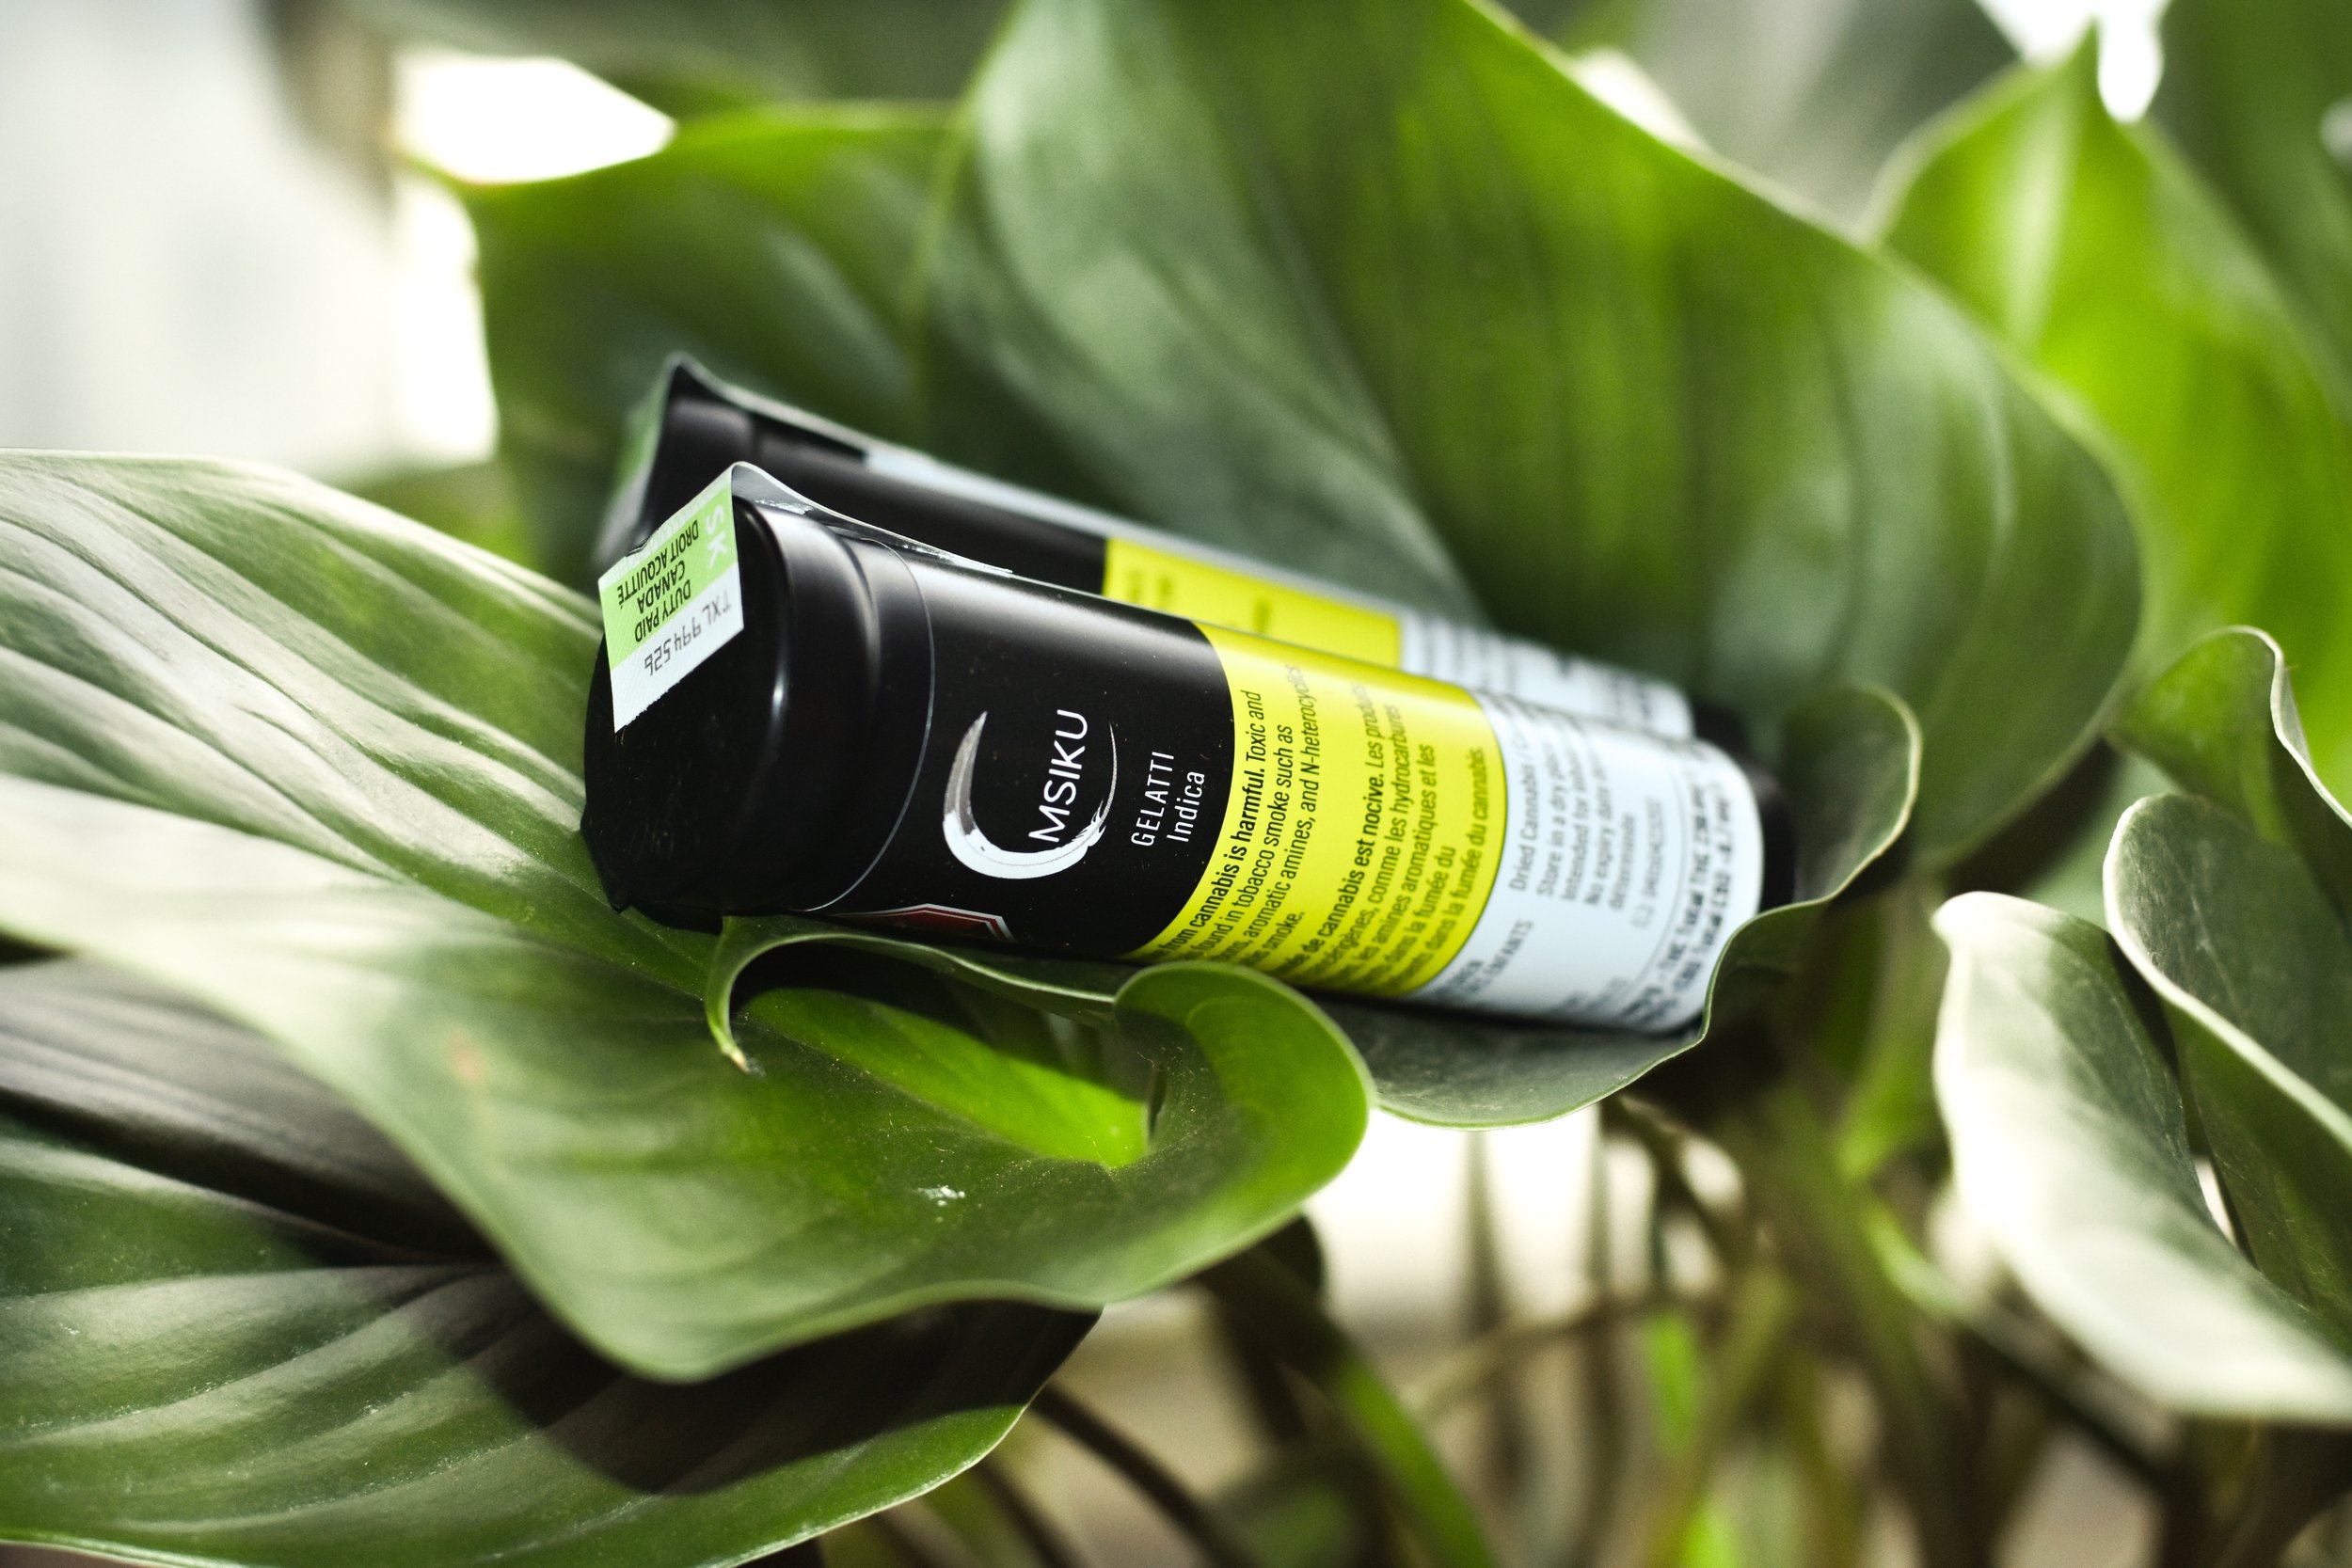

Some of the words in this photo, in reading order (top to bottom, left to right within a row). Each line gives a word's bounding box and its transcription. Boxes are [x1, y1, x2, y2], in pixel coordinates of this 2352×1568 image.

[670, 519, 699, 562] DROIT
[617, 547, 668, 610] ACQUITTÉ
[637, 560, 686, 614] CANADA
[661, 578, 691, 622] DUTY
[634, 610, 660, 642] PAID
[1240, 689, 1264, 721] and
[1245, 723, 1266, 762] Toxic
[1277, 724, 1294, 744] as
[1365, 740, 1385, 768] Les
[1416, 743, 1435, 768] les
[1028, 709, 1088, 842] MSIKU
[1273, 748, 1294, 788] such
[1384, 704, 1415, 815] hydrocarbures
[1417, 769, 1438, 787] et
[1131, 752, 1174, 847] GELATTI
[1166, 771, 1205, 842] Indica
[1230, 768, 1265, 843] harmful.
[1263, 791, 1291, 847] smoke
[1361, 772, 1385, 836] nocive.
[1384, 816, 1407, 843] les
[1401, 784, 1438, 893] aromatiques
[1465, 823, 1486, 847] du
[1223, 846, 1248, 862] is
[1242, 881, 1291, 938] aromatic
[1279, 817, 1316, 879] amines,
[1299, 778, 1320, 813] and
[1354, 838, 1376, 867] est
[1433, 845, 1456, 868] du
[1457, 848, 1483, 900] fumée
[1508, 846, 1534, 892] Dried
[1189, 863, 1240, 928] cannabis
[1232, 849, 1276, 909] tobacco
[1367, 845, 1402, 905] comme
[1413, 869, 1450, 920] fumée
[1218, 910, 1245, 923] in
[1317, 869, 1365, 938] cannabis
[1371, 894, 1412, 944] amines
[1441, 900, 1466, 917] la
[1190, 918, 1233, 955] found
[1263, 911, 1306, 951] smoke.
[1403, 920, 1427, 935] la
